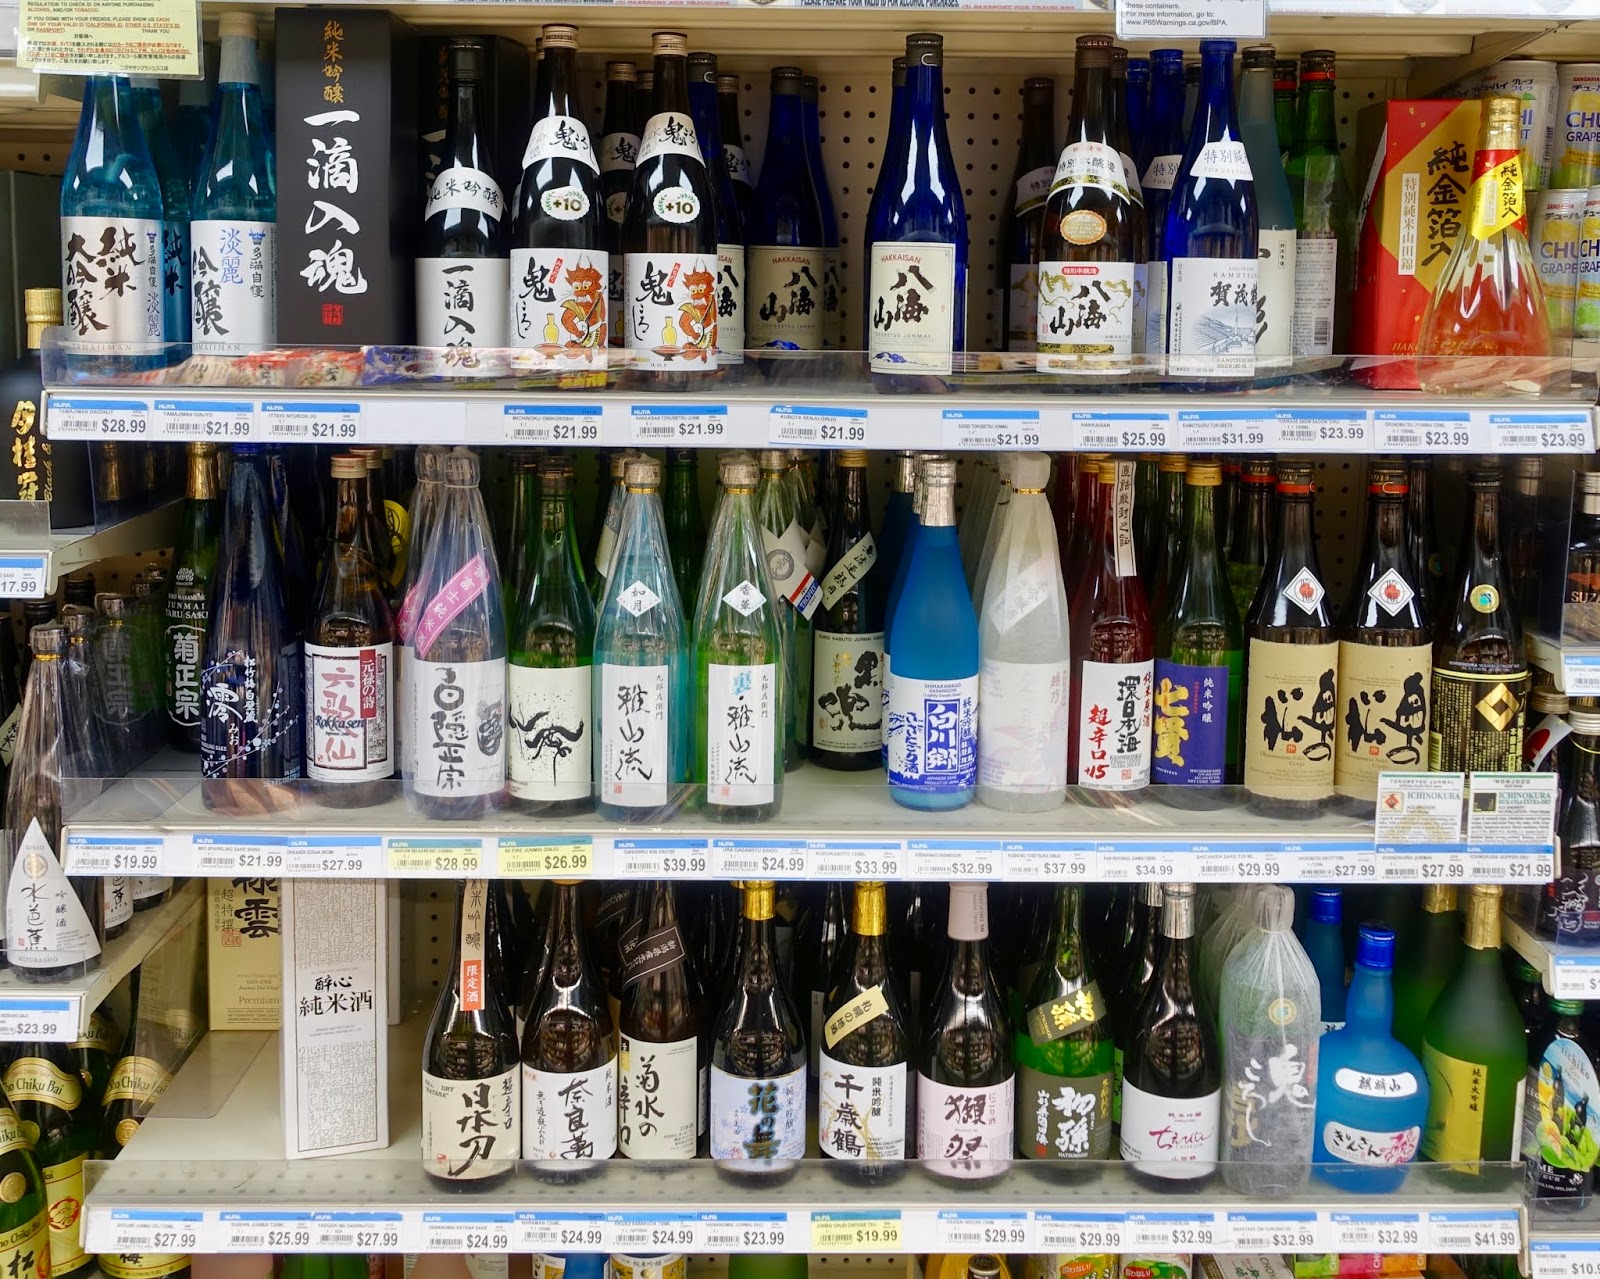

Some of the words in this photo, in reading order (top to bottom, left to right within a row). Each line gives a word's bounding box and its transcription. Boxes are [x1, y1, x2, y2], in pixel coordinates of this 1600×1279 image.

[1500, 163, 1519, 218] 純金箔入
[300, 109, 367, 295] 一滴入魂
[553, 198, 582, 212] +10
[666, 201, 694, 214] +10
[1421, 140, 1470, 267] 純金箔入
[1400, 177, 1418, 271] 特別純米山田錦
[219, 227, 244, 284] 淡麗
[772, 256, 811, 265] HAKKAISAN
[881, 253, 922, 264] HAKKAISAN
[441, 264, 480, 369] 一滴入魂
[101, 419, 146, 434] $28.99
[206, 422, 250, 437] $21.99
[311, 423, 356, 438] $21.99
[553, 425, 597, 439] $21.99
[679, 423, 723, 436] $21.99
[820, 426, 864, 441] $21.99
[1320, 427, 1364, 440] $23.99
[997, 434, 1039, 446] $21.99
[1122, 432, 1166, 446] $25.99
[1221, 432, 1264, 445] $31.99
[1425, 431, 1469, 446] $23.99
[1541, 433, 1585, 447] $23.99
[168, 602, 206, 610] JUNMAI
[173, 632, 200, 720] 菊正宗
[1202, 677, 1215, 723] 純米吟醸
[321, 667, 359, 762] 六歌仙
[1115, 675, 1141, 754] 環日本海
[315, 715, 365, 731] Rokkasen
[228, 723, 241, 746] みお
[927, 704, 958, 770] 白川郷
[1088, 704, 1112, 760] 超辛口
[1084, 764, 1110, 780] +15
[1407, 791, 1461, 800] ICHINOKURA
[1499, 791, 1551, 800] ICHINOKURA
[114, 854, 158, 869] $19.99
[238, 853, 282, 867] $21.99
[321, 859, 362, 871] $27.99
[435, 857, 478, 871] $28.99
[544, 854, 587, 869] $26.99
[663, 857, 706, 872] $39.99
[762, 857, 804, 871] $24.99
[855, 861, 897, 875] $33.99
[952, 863, 992, 874] $32.99
[1044, 863, 1085, 875] $37.99
[1136, 864, 1173, 876] $34.99
[1238, 863, 1280, 876] $29.99
[1335, 865, 1375, 876] $27.99
[1422, 864, 1464, 877] $27.99
[1509, 864, 1551, 877] $21.99
[55, 890, 68, 928] 吟醸酒
[466, 964, 479, 1003] 限定酒
[299, 990, 373, 1017] 純米酒
[17, 1023, 57, 1035] $23.99
[17, 1078, 45, 1091] Chiku
[46, 1080, 64, 1095] Bai
[121, 1076, 149, 1092] Chiku
[832, 1074, 866, 1157] 千歳鶴
[945, 1094, 987, 1170] 獺祭
[154, 1233, 196, 1247] $27.99
[268, 1231, 310, 1246] $25.99
[357, 1232, 398, 1247] $27.99
[467, 1234, 508, 1249] $24.99
[561, 1230, 602, 1245] $24.99
[652, 1230, 693, 1245] $24.99
[743, 1231, 784, 1246] $23.99
[856, 1229, 898, 1243] $19.99
[984, 1229, 1025, 1243] $29.99
[1080, 1232, 1120, 1247] $29.99
[1172, 1229, 1213, 1244] $32.99
[1273, 1233, 1314, 1246] $32.99
[1378, 1231, 1418, 1245] $32.99
[1474, 1232, 1515, 1246] $41.99
